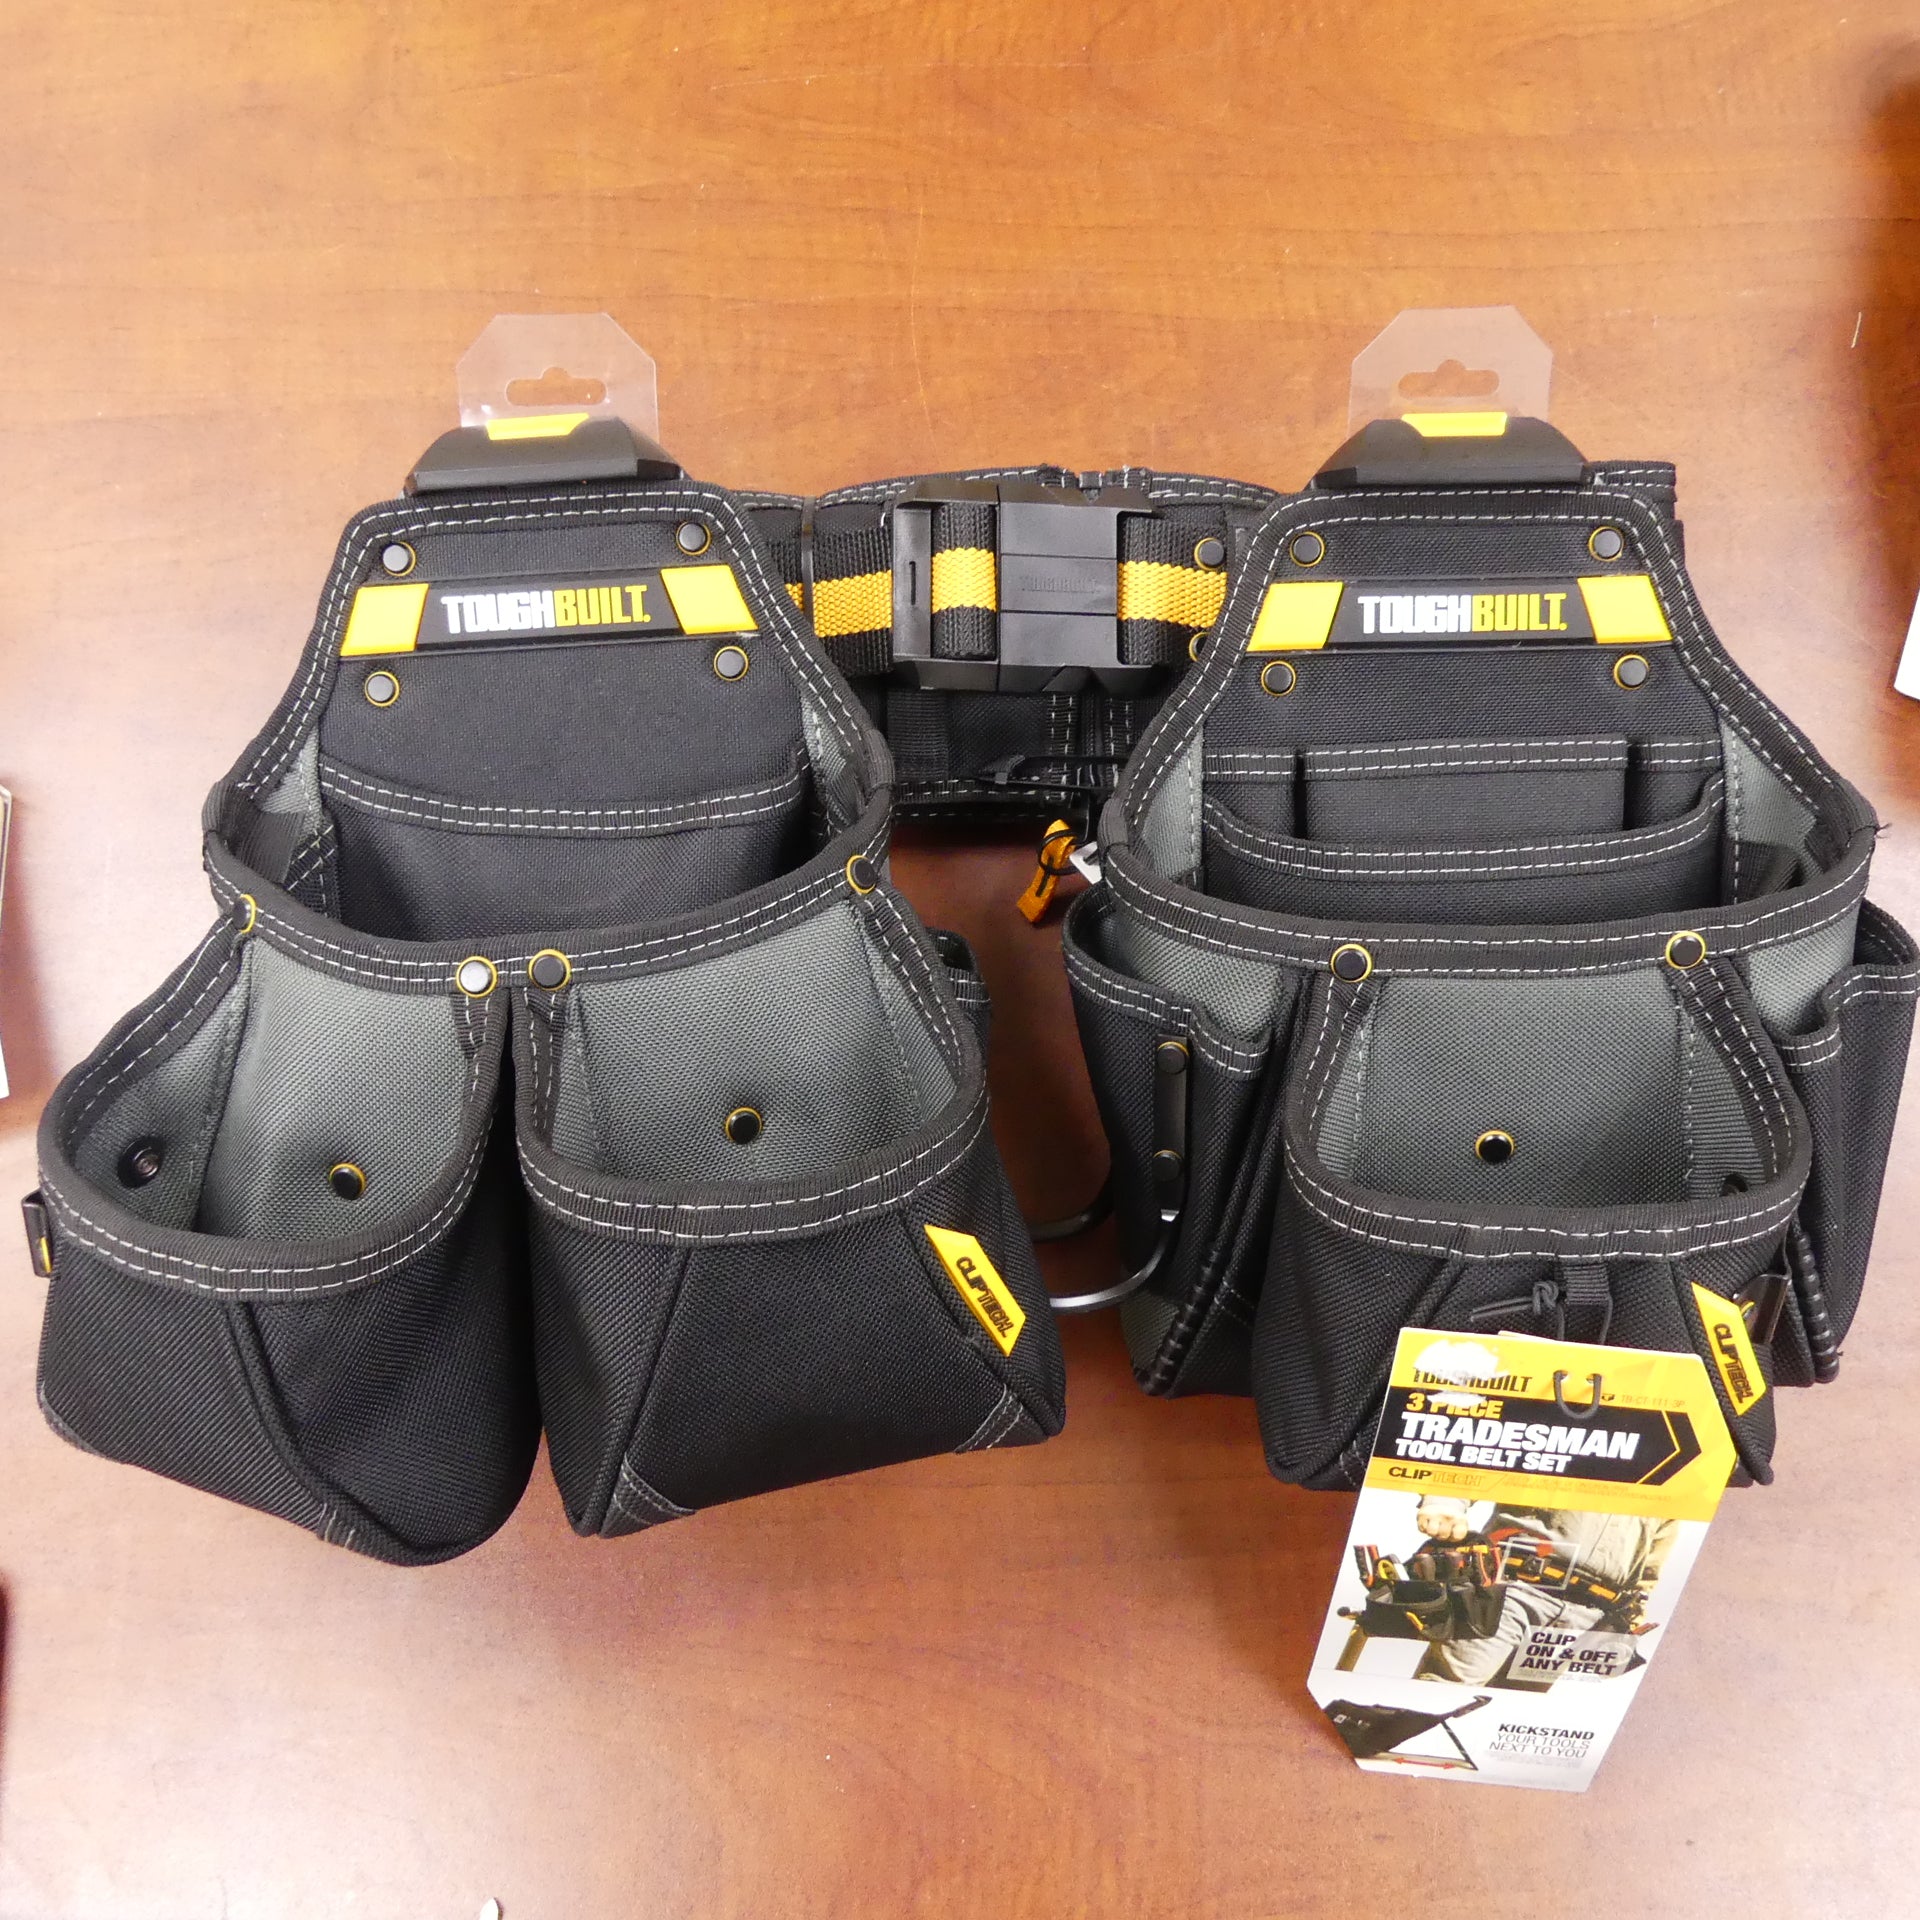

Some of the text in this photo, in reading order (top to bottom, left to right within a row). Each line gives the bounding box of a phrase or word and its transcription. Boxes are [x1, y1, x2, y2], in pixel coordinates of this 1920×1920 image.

[956, 1256, 1014, 1338] CLIPTECH
[1713, 1322, 1754, 1404] CLIPTECH
[1406, 1392, 1425, 1412] 3
[1400, 1412, 1640, 1460] TRADESMAN
[1396, 1438, 1572, 1473] TOOL BELT SET
[1387, 1466, 1485, 1488] CLIPTECH
[1531, 1632, 1576, 1646] CLIP
[1526, 1645, 1618, 1663] ON & OFF
[1519, 1657, 1617, 1675] ANY BELT
[1498, 1723, 1595, 1740] KICKSTAND
[1489, 1742, 1528, 1753] NEXT
[1533, 1745, 1552, 1755] TO
[1556, 1748, 1588, 1759] YOU
[1497, 1733, 1591, 1750] YOUR TOOLS
